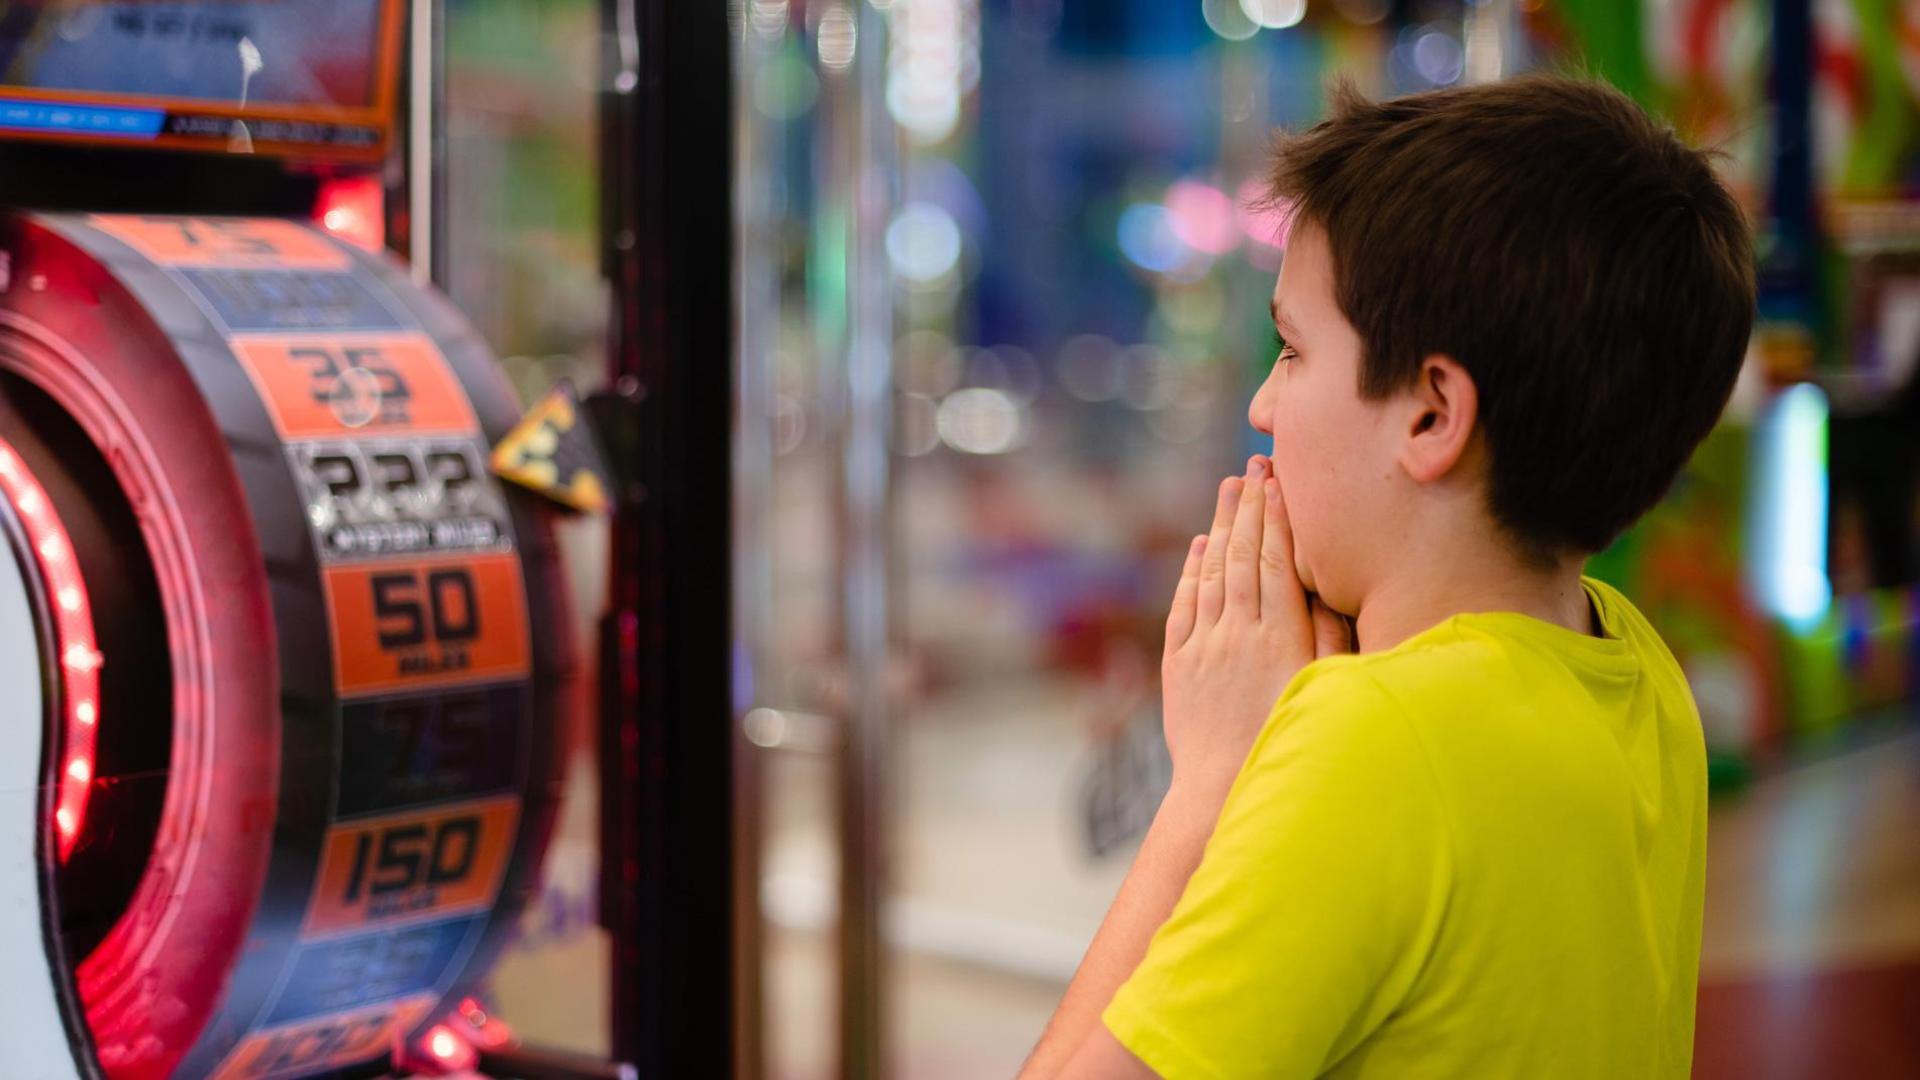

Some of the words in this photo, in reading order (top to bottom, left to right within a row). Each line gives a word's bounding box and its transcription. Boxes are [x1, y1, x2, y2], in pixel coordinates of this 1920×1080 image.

[289, 348, 411, 401] 35
[371, 569, 481, 651] 50
[342, 817, 482, 905] 150
